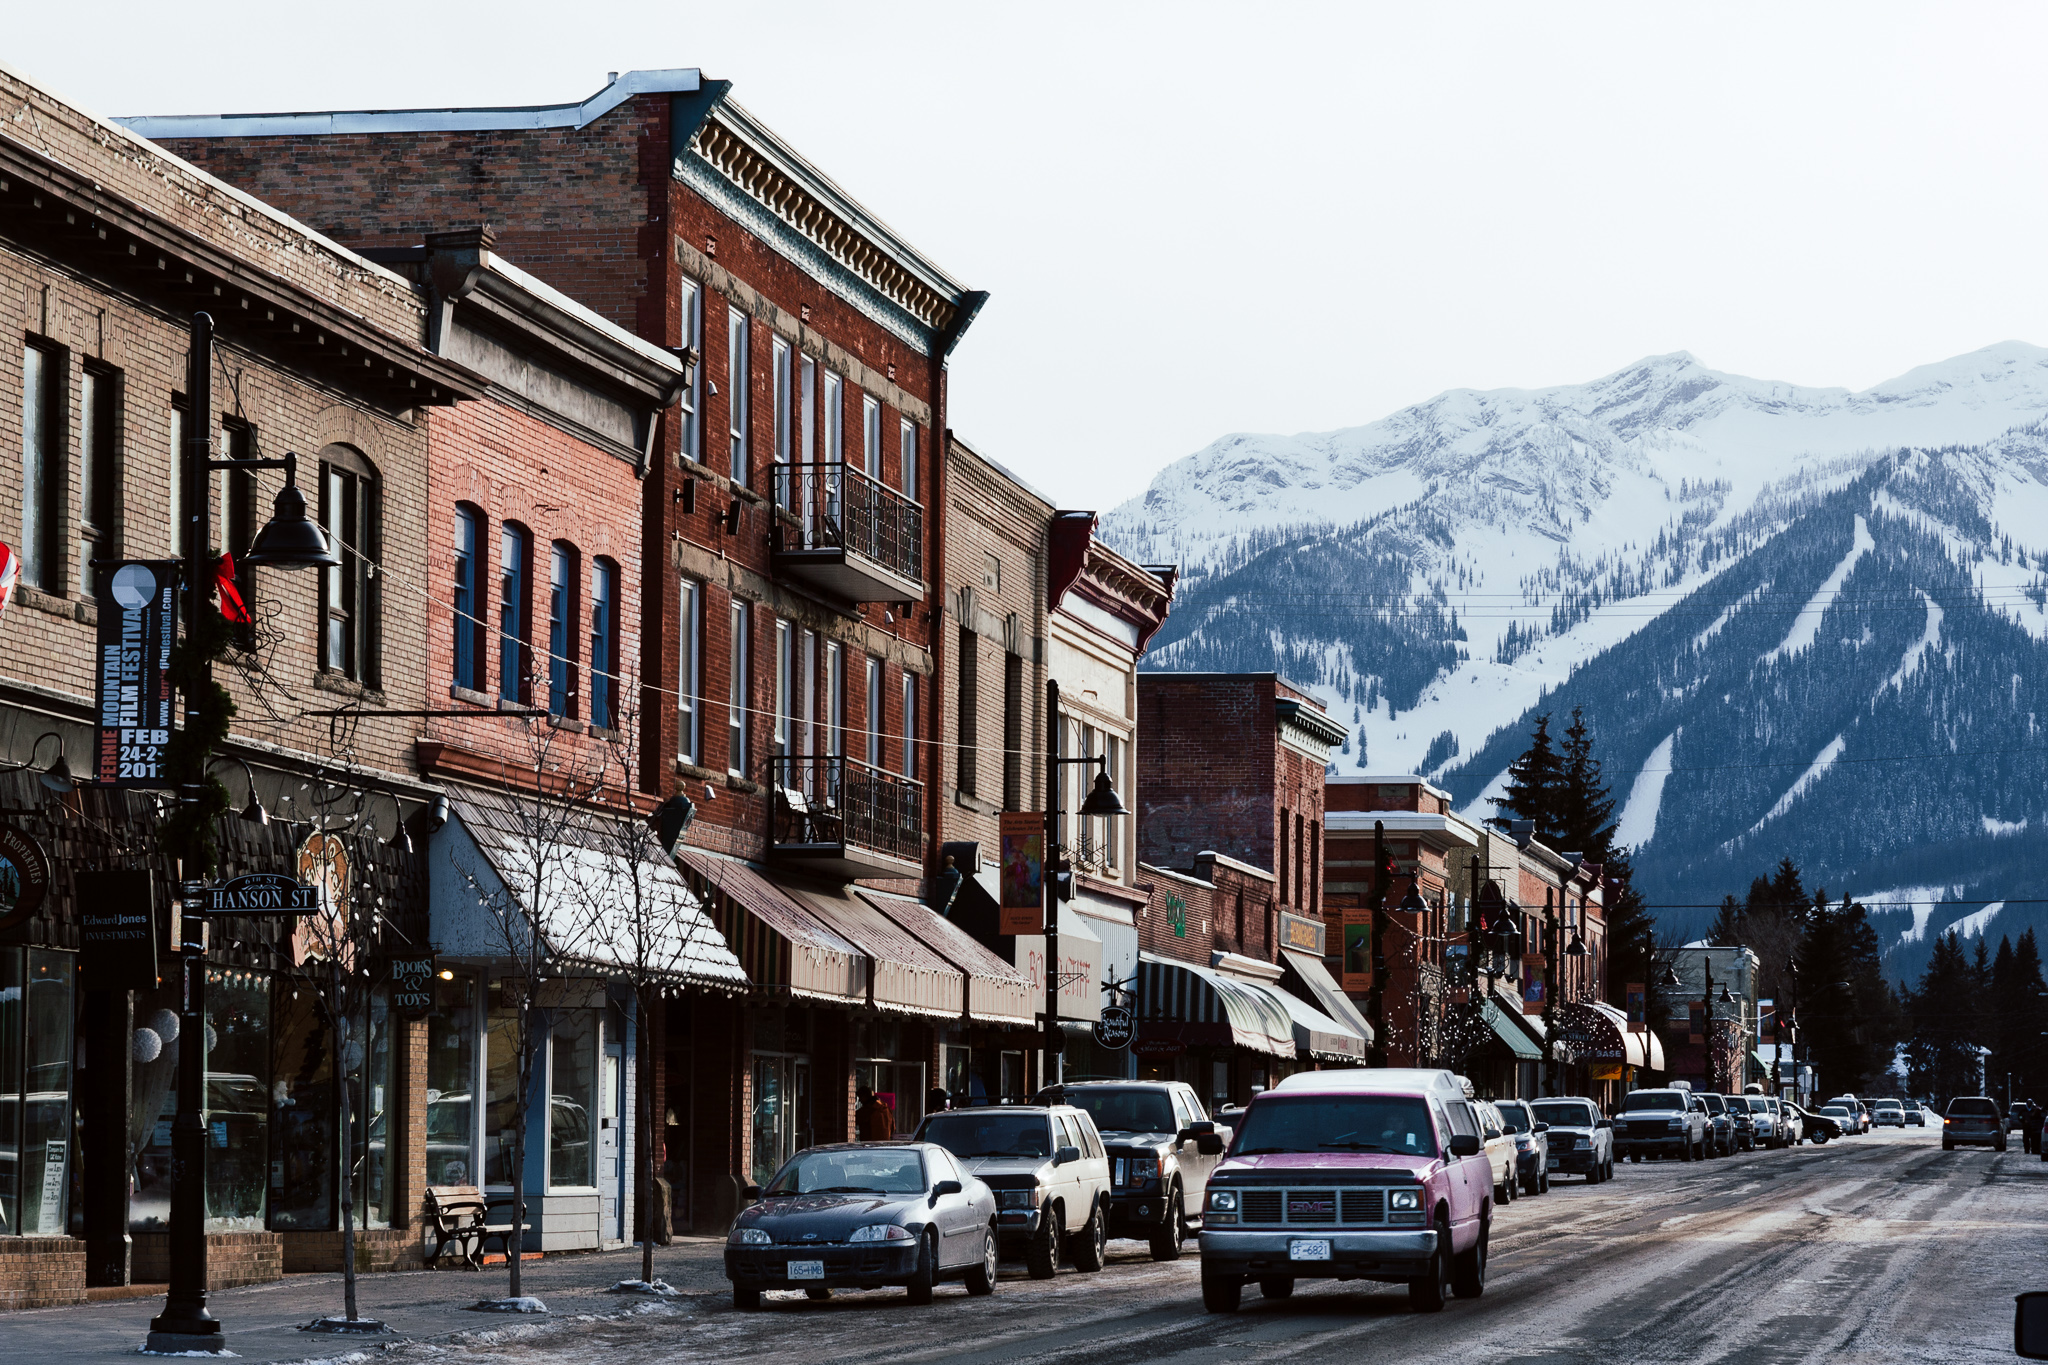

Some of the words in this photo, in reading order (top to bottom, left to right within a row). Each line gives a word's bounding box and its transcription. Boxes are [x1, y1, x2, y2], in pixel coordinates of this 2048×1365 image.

[121, 599, 142, 681] FESTIVAL
[102, 644, 121, 727] MOUNTAIN
[119, 685, 139, 727] FILM
[121, 728, 169, 744] FEB
[100, 730, 118, 783] FERNIE
[3, 829, 42, 885] PROPERTIES
[245, 876, 261, 885] 6TH
[266, 876, 279, 884] ST
[213, 890, 283, 908] HANSON
[291, 889, 311, 907] ST
[85, 929, 147, 941] INVESTMENTS
[391, 958, 433, 980] BOOKS
[403, 974, 423, 991] &
[394, 992, 431, 1007] TOYS
[1098, 1011, 1129, 1030] Beautiful
[1101, 1025, 1129, 1042] Reasons
[1596, 1049, 1623, 1058] BASE
[1289, 1201, 1334, 1212] GMC
